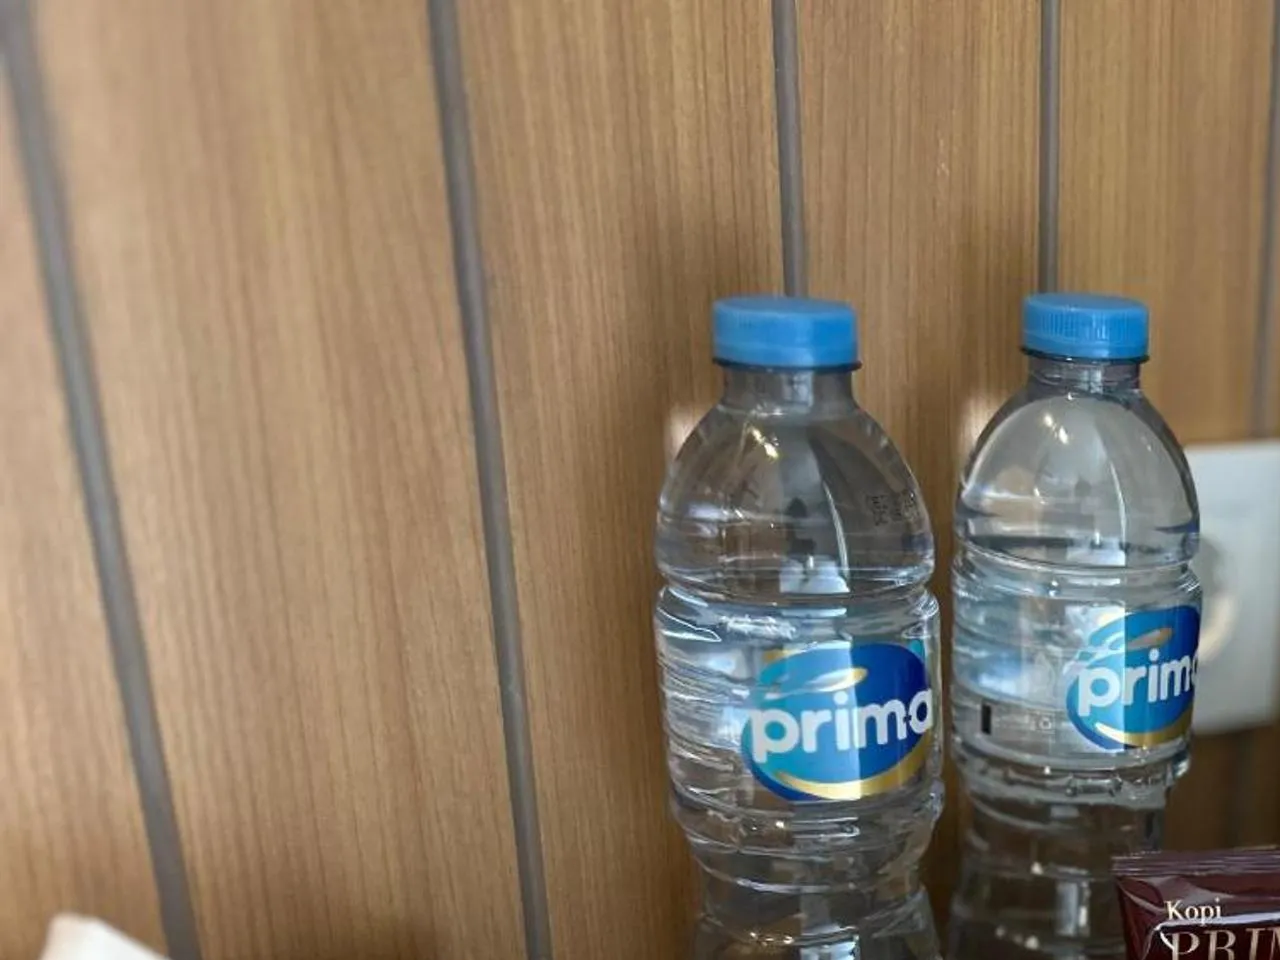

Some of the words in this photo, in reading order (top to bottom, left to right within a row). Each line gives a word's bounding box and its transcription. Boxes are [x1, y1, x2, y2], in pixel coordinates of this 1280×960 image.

[1077, 648, 1197, 717] prim
[750, 688, 933, 764] prima
[1166, 897, 1222, 924] Kopi
